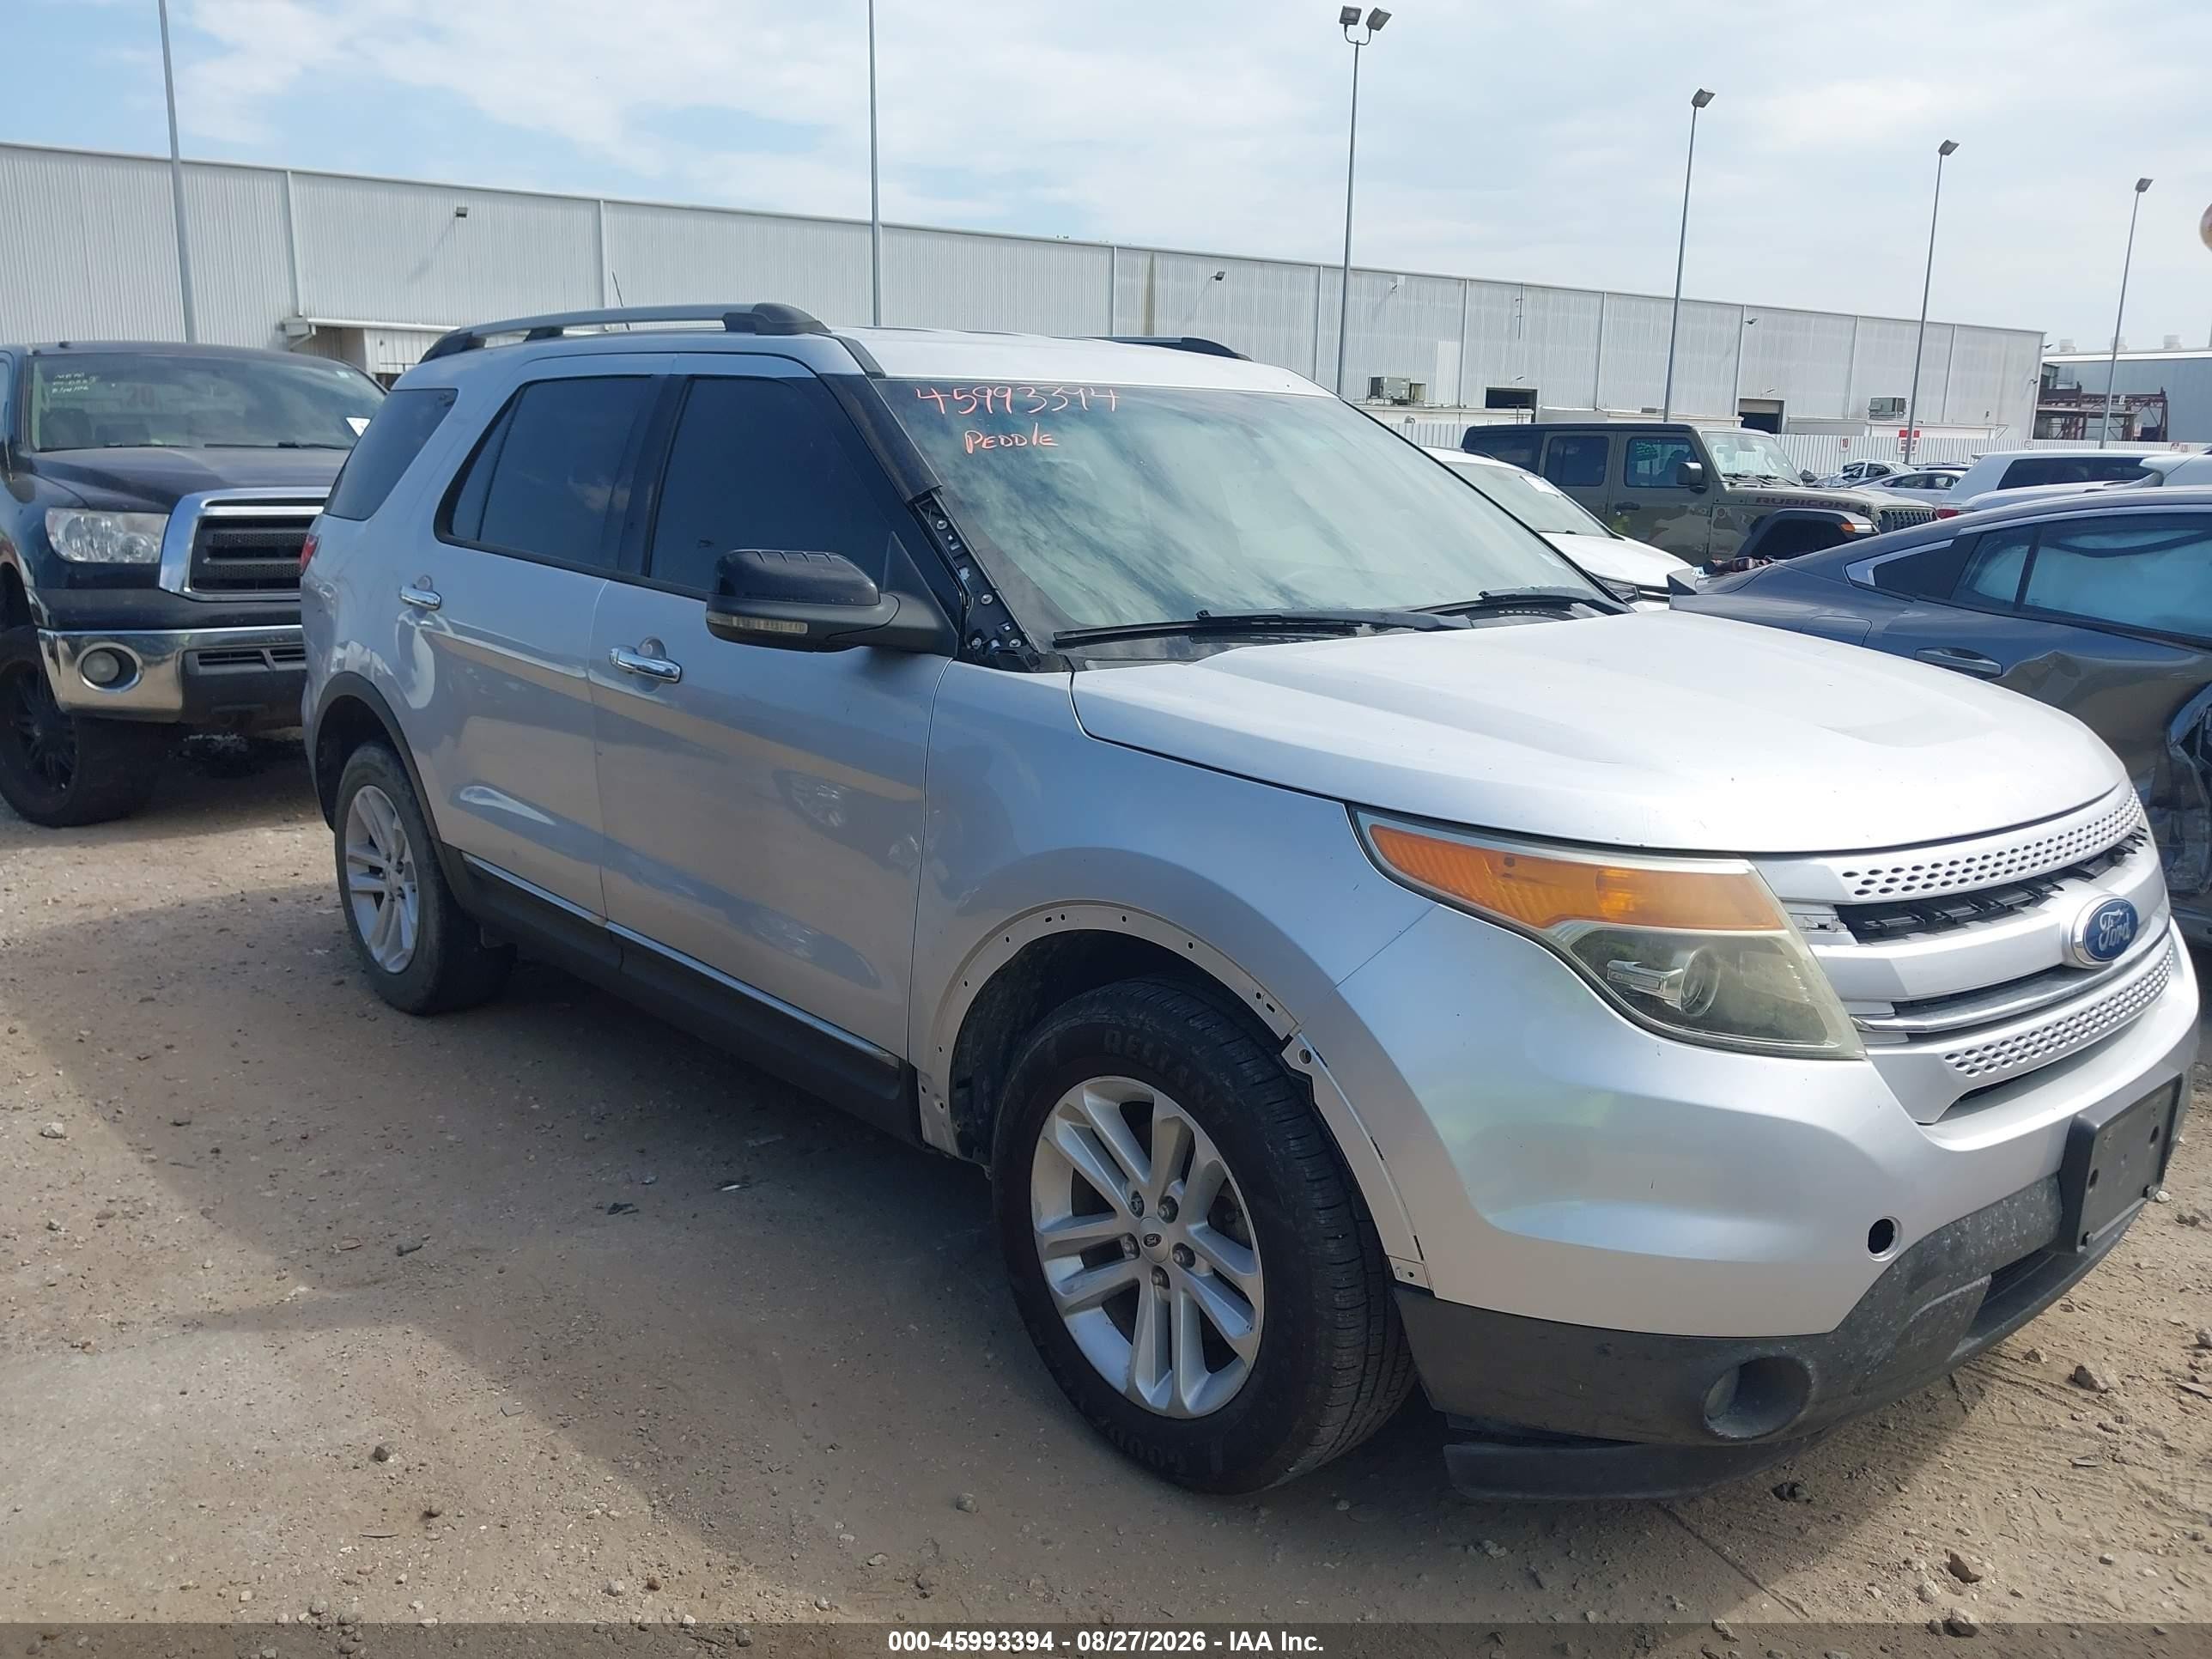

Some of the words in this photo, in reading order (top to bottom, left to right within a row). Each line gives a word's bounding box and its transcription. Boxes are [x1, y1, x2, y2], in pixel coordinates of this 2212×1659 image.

[915, 386, 1120, 414] 45993394
[1755, 496, 1850, 510] RUBICON
[2098, 907, 2131, 951] Ford
